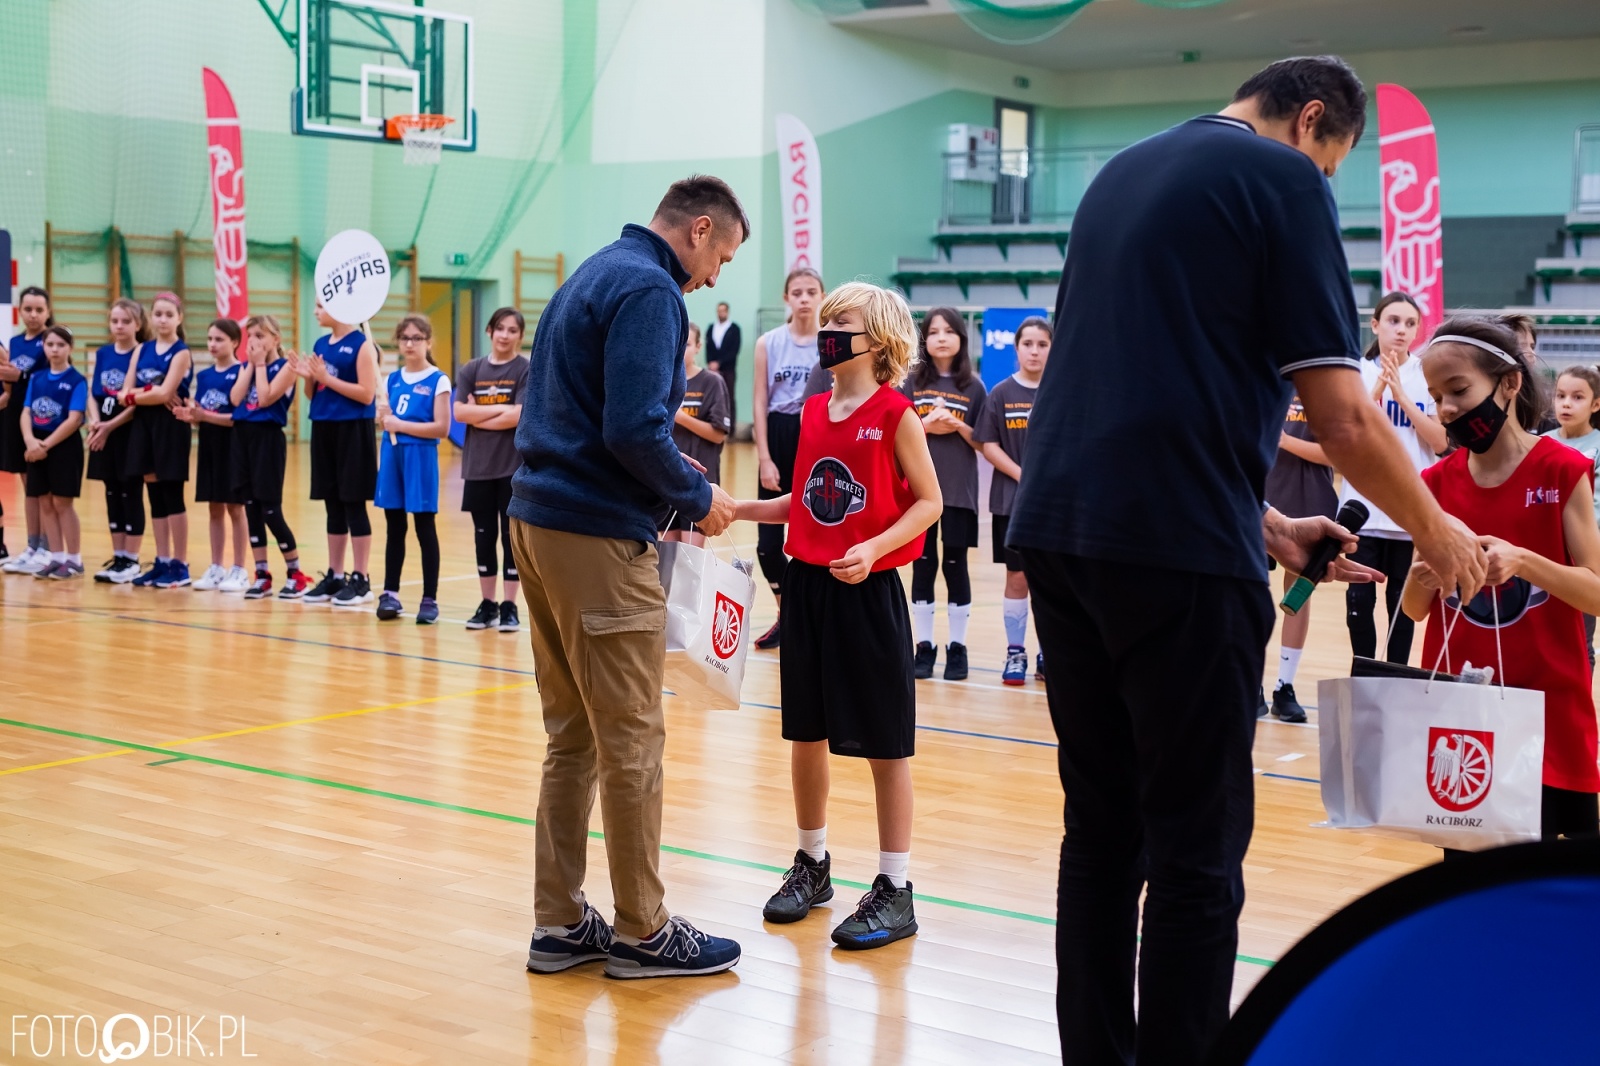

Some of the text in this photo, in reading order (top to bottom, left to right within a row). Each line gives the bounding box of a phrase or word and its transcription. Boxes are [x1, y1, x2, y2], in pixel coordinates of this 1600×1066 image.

[322, 258, 386, 303] SPURS
[396, 393, 411, 415] 6
[834, 478, 863, 497] ROCKETS
[705, 655, 730, 674] RACIBÓRZ
[1425, 814, 1483, 828] RACIBÓRZ
